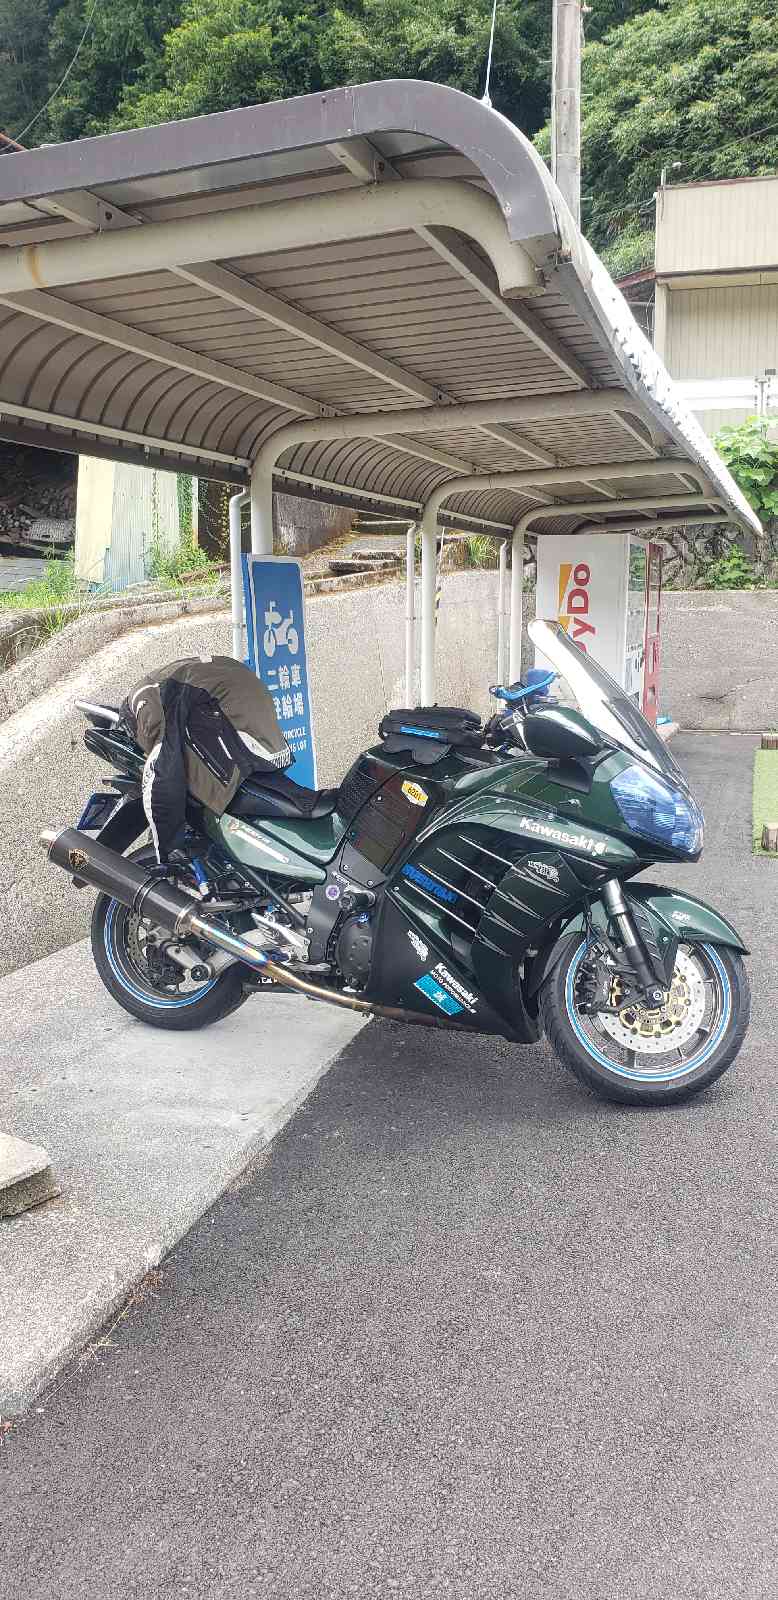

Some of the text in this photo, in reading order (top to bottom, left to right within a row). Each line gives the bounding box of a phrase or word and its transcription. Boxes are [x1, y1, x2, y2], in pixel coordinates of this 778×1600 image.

[267, 664, 301, 690] 二輪車
[520, 817, 595, 850] Kawasaki
[434, 962, 479, 1005] Kawasaki
